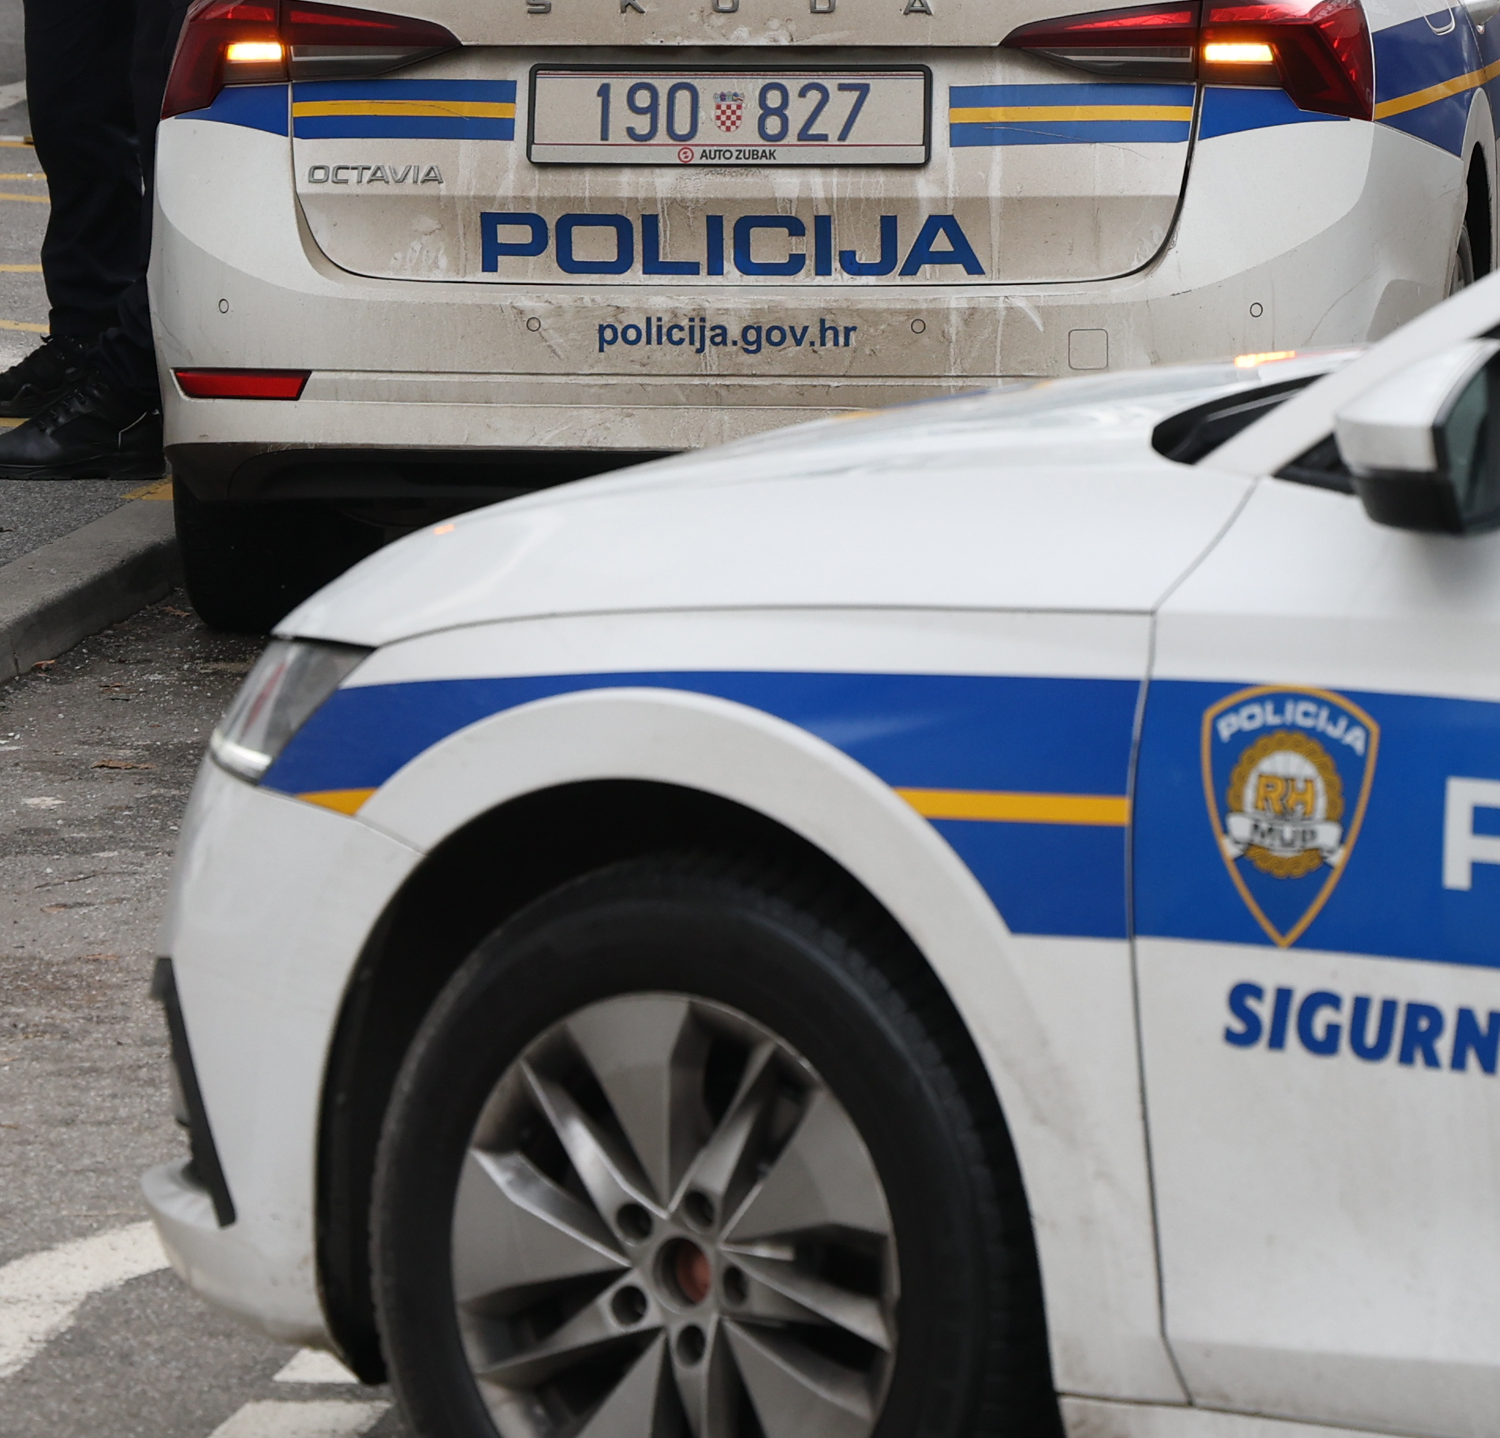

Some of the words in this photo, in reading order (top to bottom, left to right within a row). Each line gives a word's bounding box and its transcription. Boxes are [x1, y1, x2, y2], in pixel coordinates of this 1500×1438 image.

[596, 81, 700, 142] 190
[757, 81, 871, 143] 827
[307, 164, 444, 184] OCTAVIA
[699, 148, 733, 161] AUTO
[735, 148, 777, 161] ZUBAK
[480, 211, 986, 277] POLICIJA
[598, 316, 857, 354] policija.gov.hr
[1216, 699, 1368, 756] POLICIJA
[1257, 774, 1315, 817] RH
[1252, 821, 1318, 849] MUP
